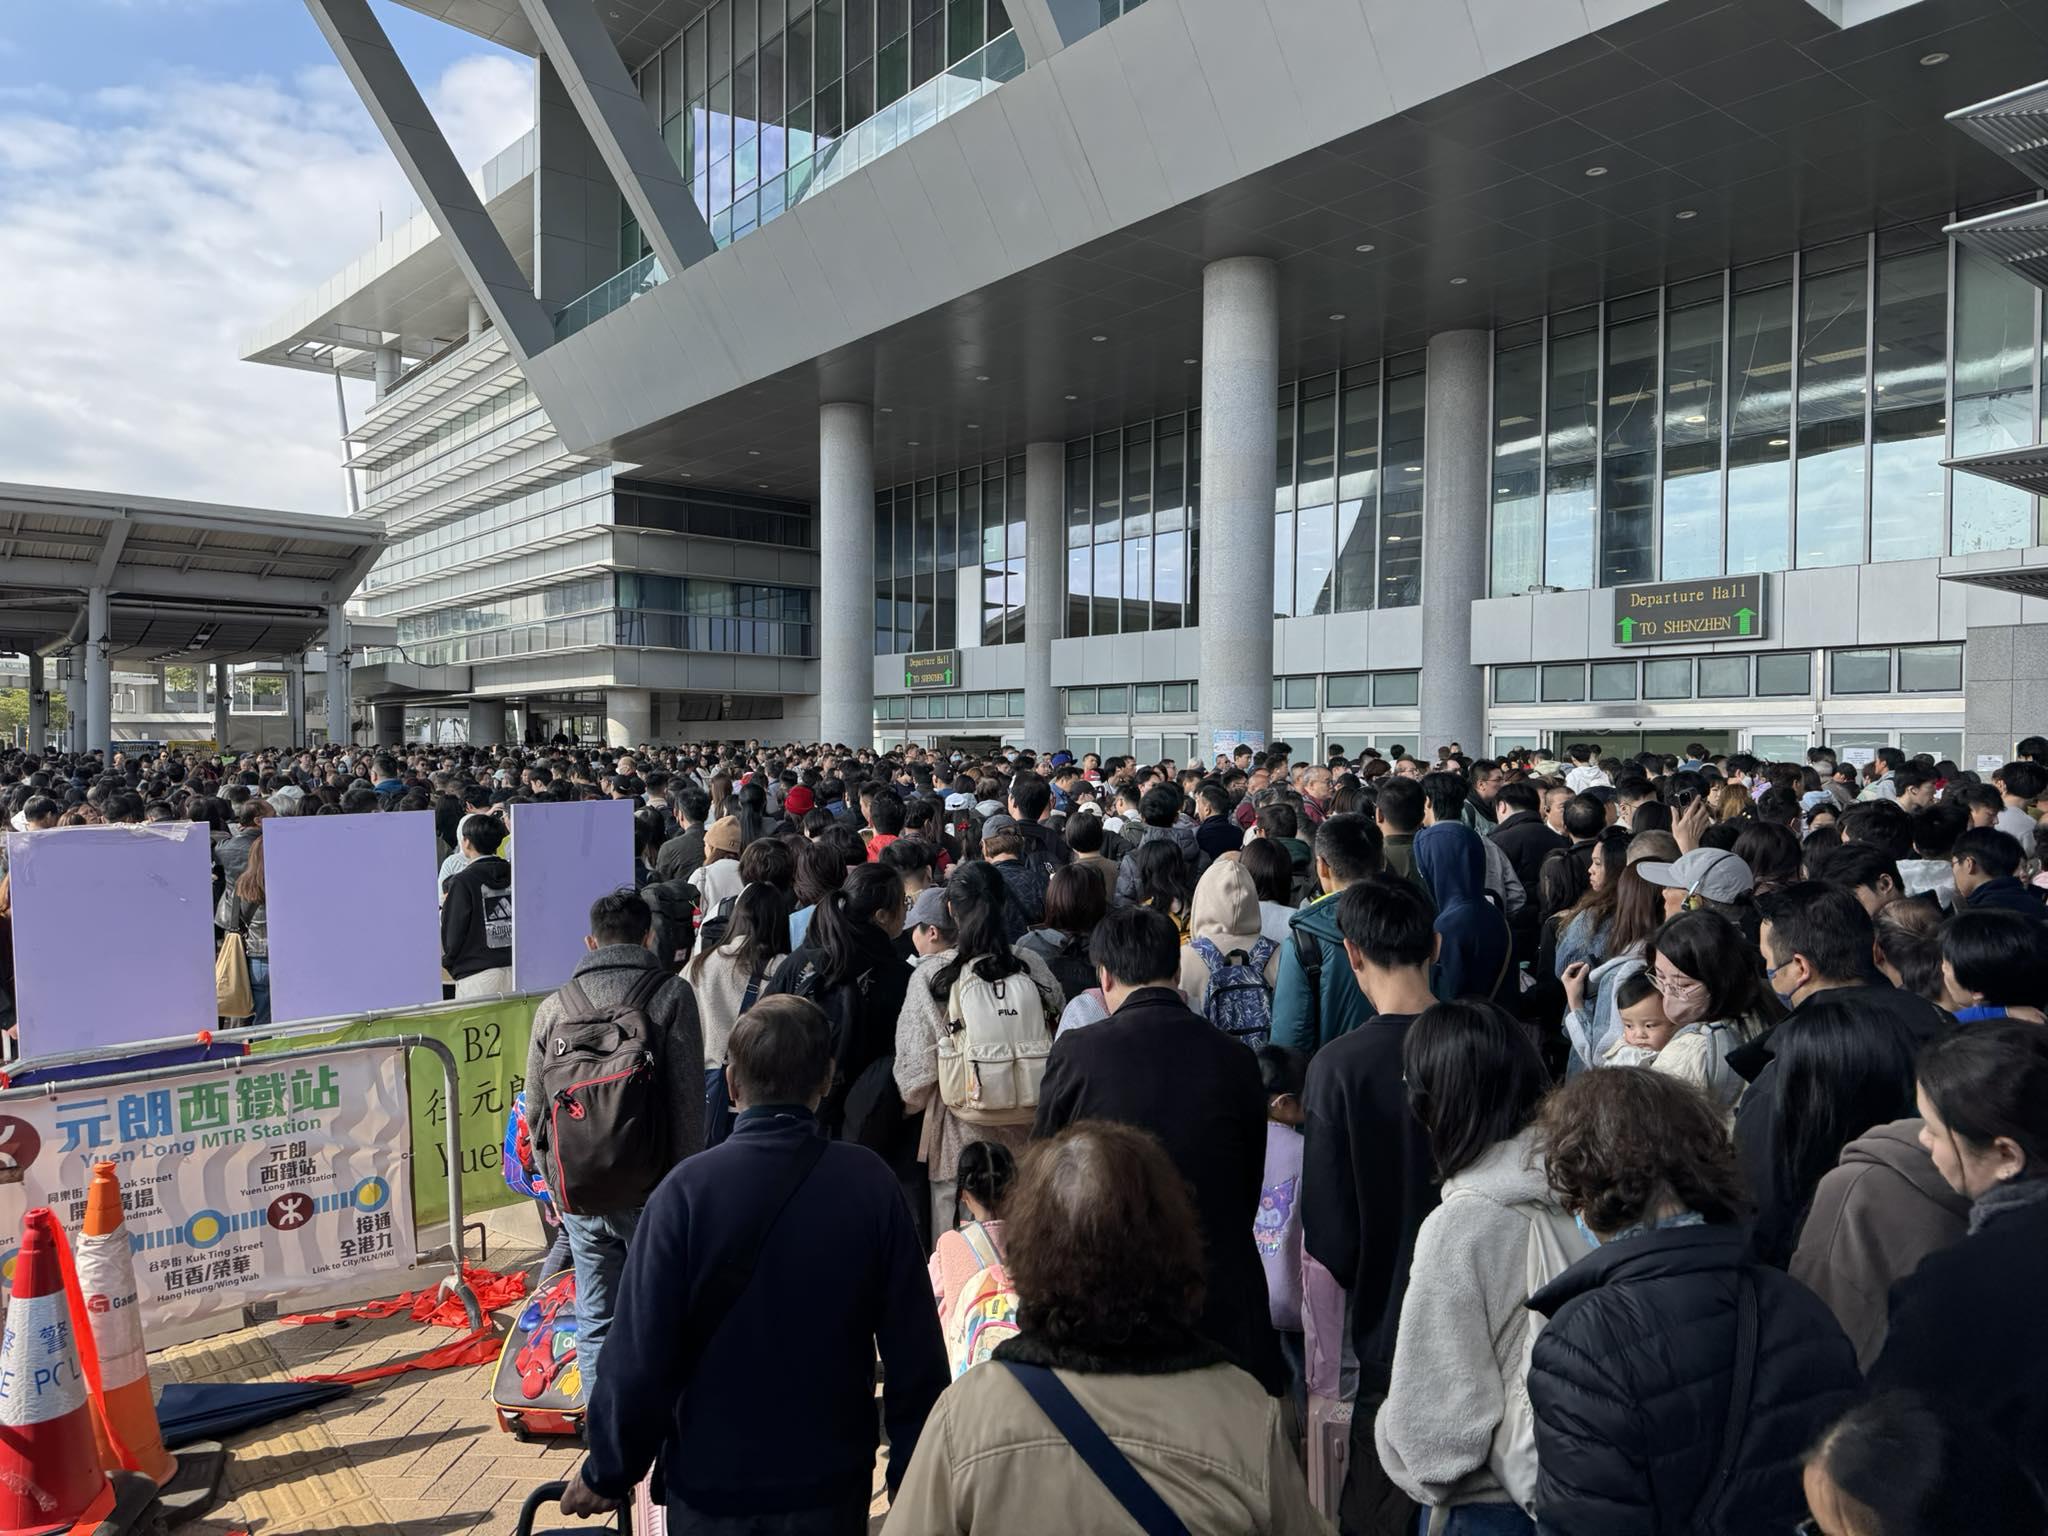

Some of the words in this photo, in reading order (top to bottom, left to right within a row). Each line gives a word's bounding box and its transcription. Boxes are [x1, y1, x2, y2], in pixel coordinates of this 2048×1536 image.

[1630, 591, 1704, 608] Departure
[1712, 583, 1746, 600] Hall
[1640, 622, 1657, 635] TO
[1664, 616, 1731, 634] SHENZHEN
[998, 1008, 1018, 1016] FILA
[463, 1023, 501, 1063] B2
[56, 1064, 341, 1153] 元朗西鐵站
[80, 1151, 135, 1169] Yuen
[142, 1140, 195, 1160] Long
[201, 1129, 246, 1149] MTR
[252, 1118, 321, 1141] Station
[270, 1141, 307, 1162] 元朗
[260, 1158, 316, 1184] 西鐵站
[435, 1141, 504, 1177] Yue
[140, 1173, 172, 1186] Street
[240, 1187, 262, 1197] Yuen
[264, 1183, 285, 1193] Long
[287, 1178, 306, 1187] MTR
[308, 1172, 337, 1184] Station
[356, 1212, 391, 1234] 接通
[186, 1252, 206, 1264] Kuk
[208, 1249, 230, 1259] Ting
[233, 1241, 264, 1253] Street
[340, 1232, 393, 1259] 全港九
[149, 1257, 182, 1272] 谷亭街
[312, 1265, 330, 1274] Link
[332, 1262, 341, 1270] to
[342, 1249, 395, 1267] City/KLN/HKI
[157, 1291, 182, 1302] Hang
[184, 1278, 239, 1297] Heung/Wing
[240, 1273, 260, 1283] Wah
[40, 1320, 68, 1354] 警
